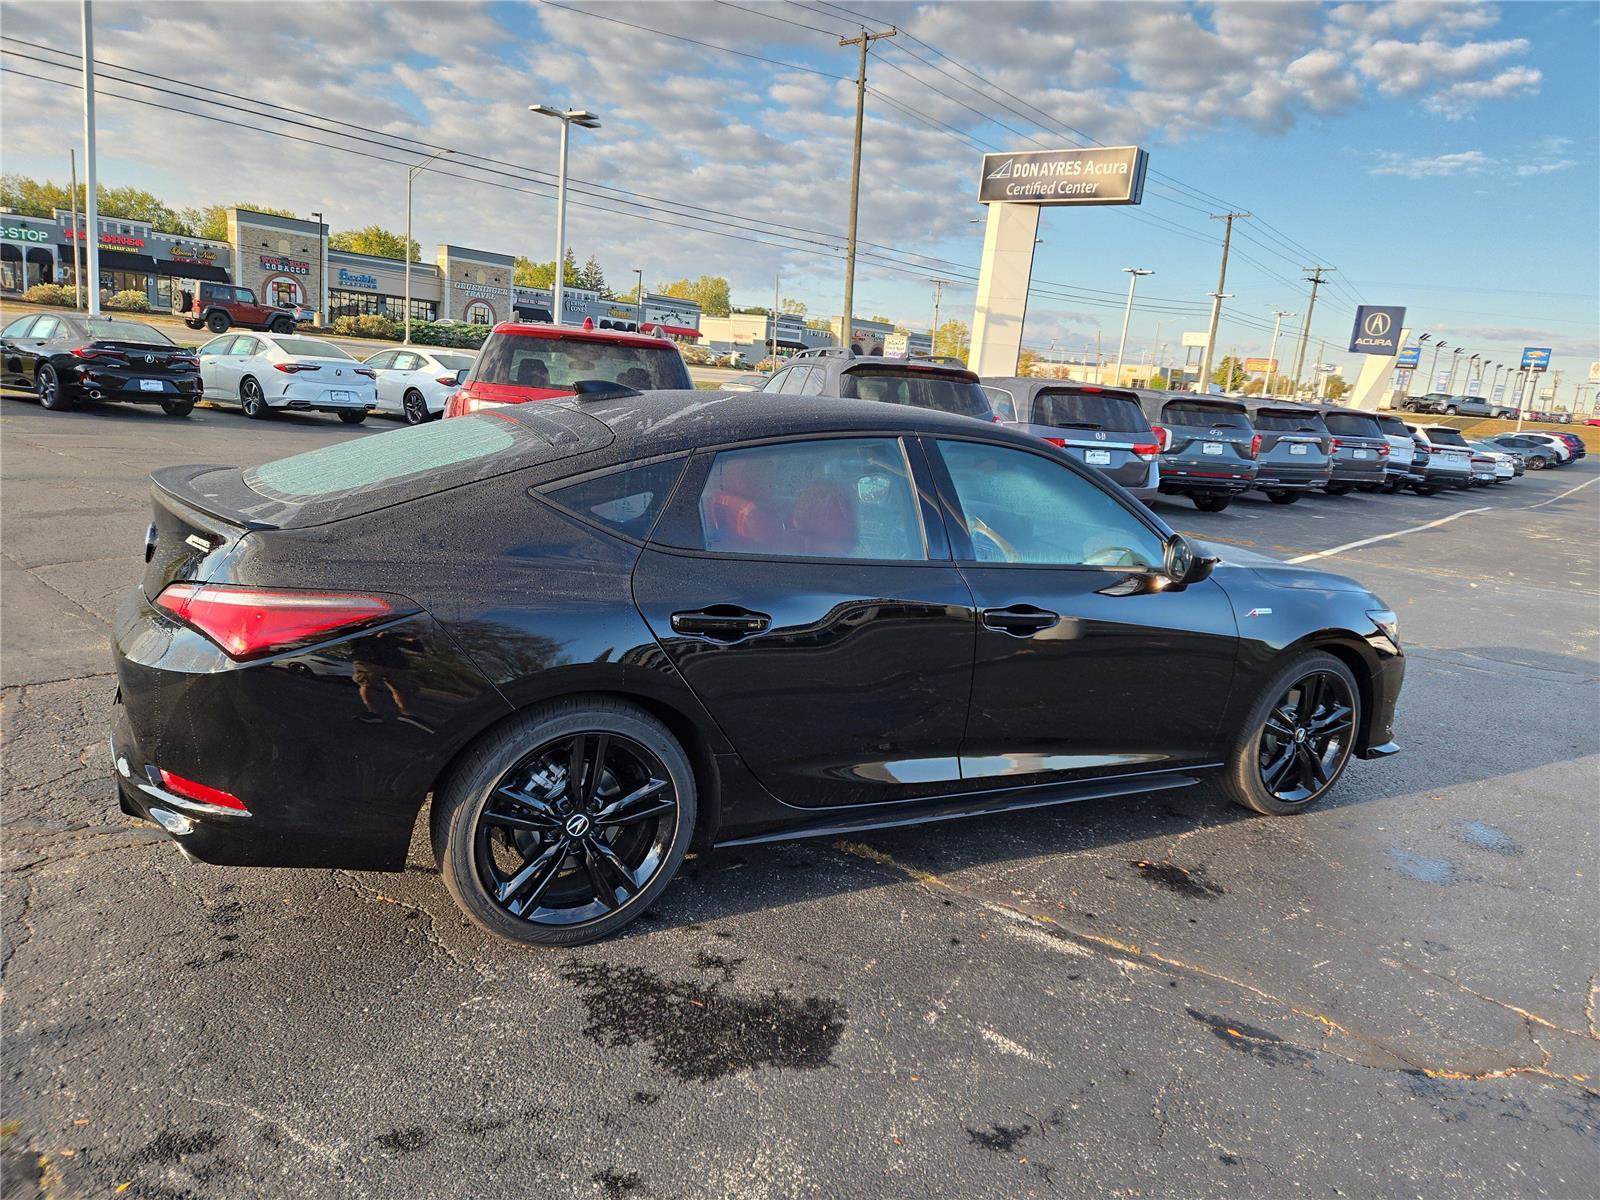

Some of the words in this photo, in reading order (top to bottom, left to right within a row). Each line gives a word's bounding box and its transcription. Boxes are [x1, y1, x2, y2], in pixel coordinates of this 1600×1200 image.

[1013, 163, 1039, 178] DON
[1040, 160, 1081, 176] AYRES
[1083, 159, 1128, 175] Acura
[1006, 180, 1056, 196] Certified
[1057, 181, 1099, 195] Center
[101, 233, 145, 248] DINER
[265, 263, 307, 274] TOBACCO
[464, 290, 496, 300] TRAVEL
[1354, 337, 1393, 347] ACURA
